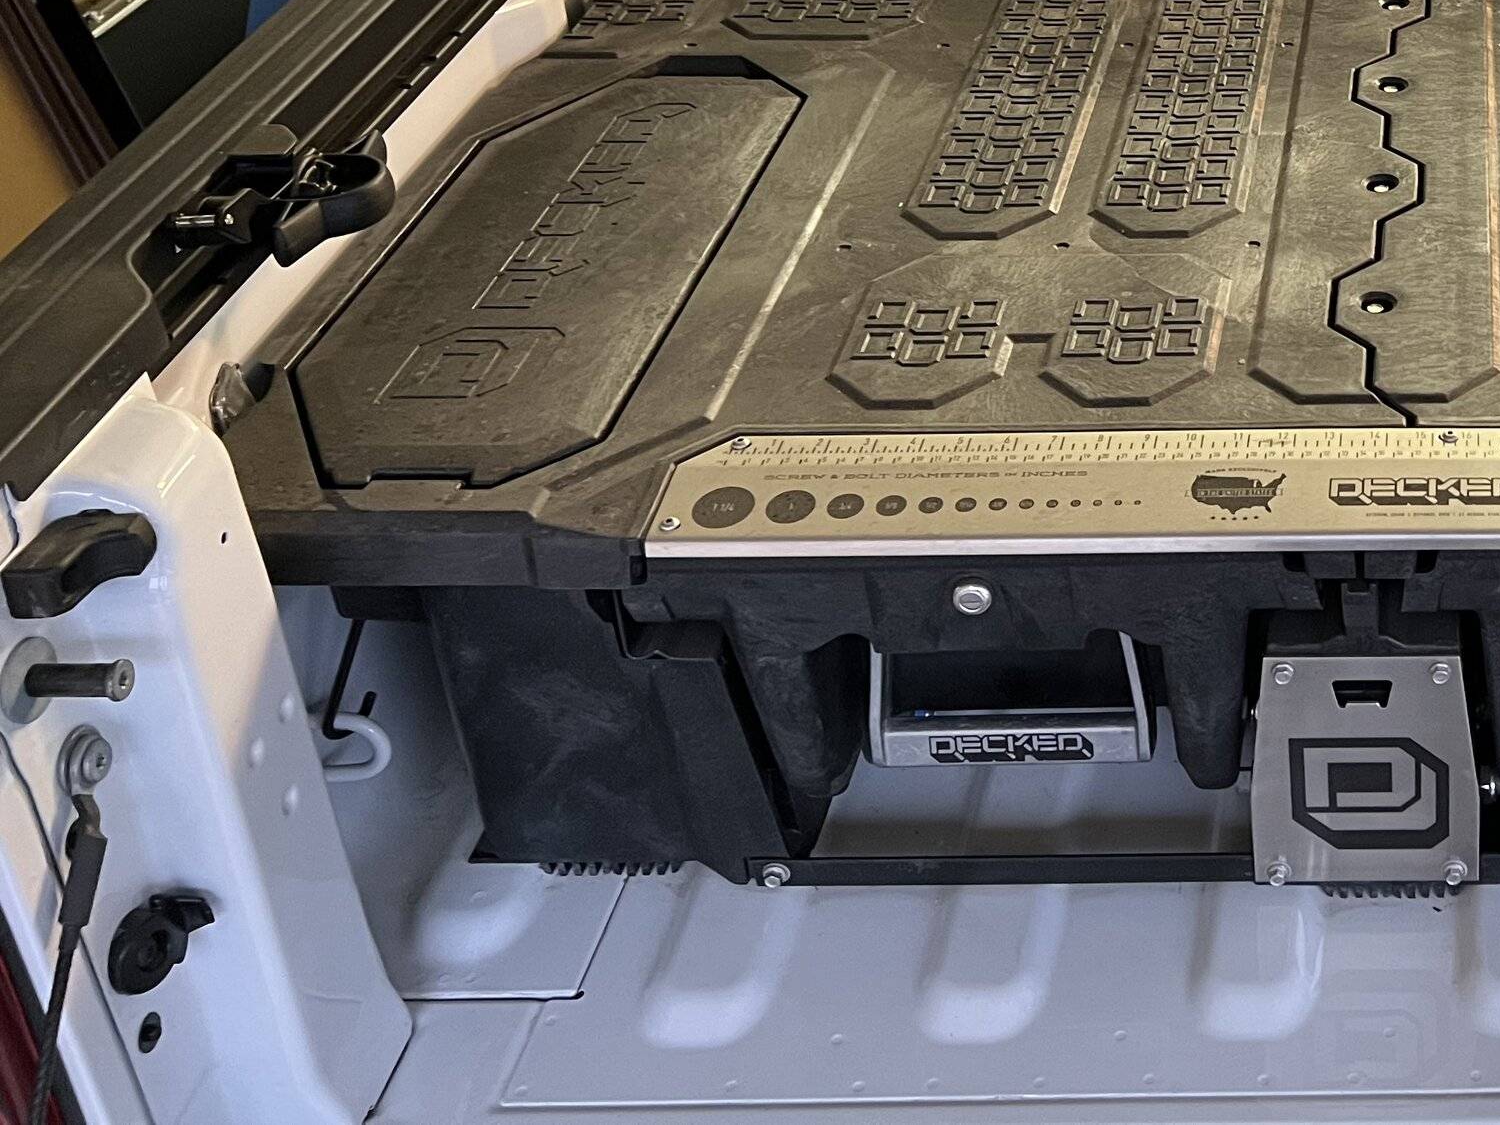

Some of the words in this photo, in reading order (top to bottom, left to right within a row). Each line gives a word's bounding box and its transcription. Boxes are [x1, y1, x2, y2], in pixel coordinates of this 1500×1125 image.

[771, 439, 777, 447] 1
[816, 439, 824, 447] 2
[910, 437, 917, 445] 4
[957, 437, 964, 445] 5
[1004, 436, 1010, 444] 6
[1051, 436, 1058, 444] 7
[1144, 434, 1150, 442] 9
[1278, 432, 1289, 440] 12
[1370, 431, 1381, 439] 14
[1416, 431, 1426, 439] 15
[843, 472, 890, 480] BOLT
[896, 471, 1000, 479] DIAMETERS
[928, 733, 1095, 763] DECKED
